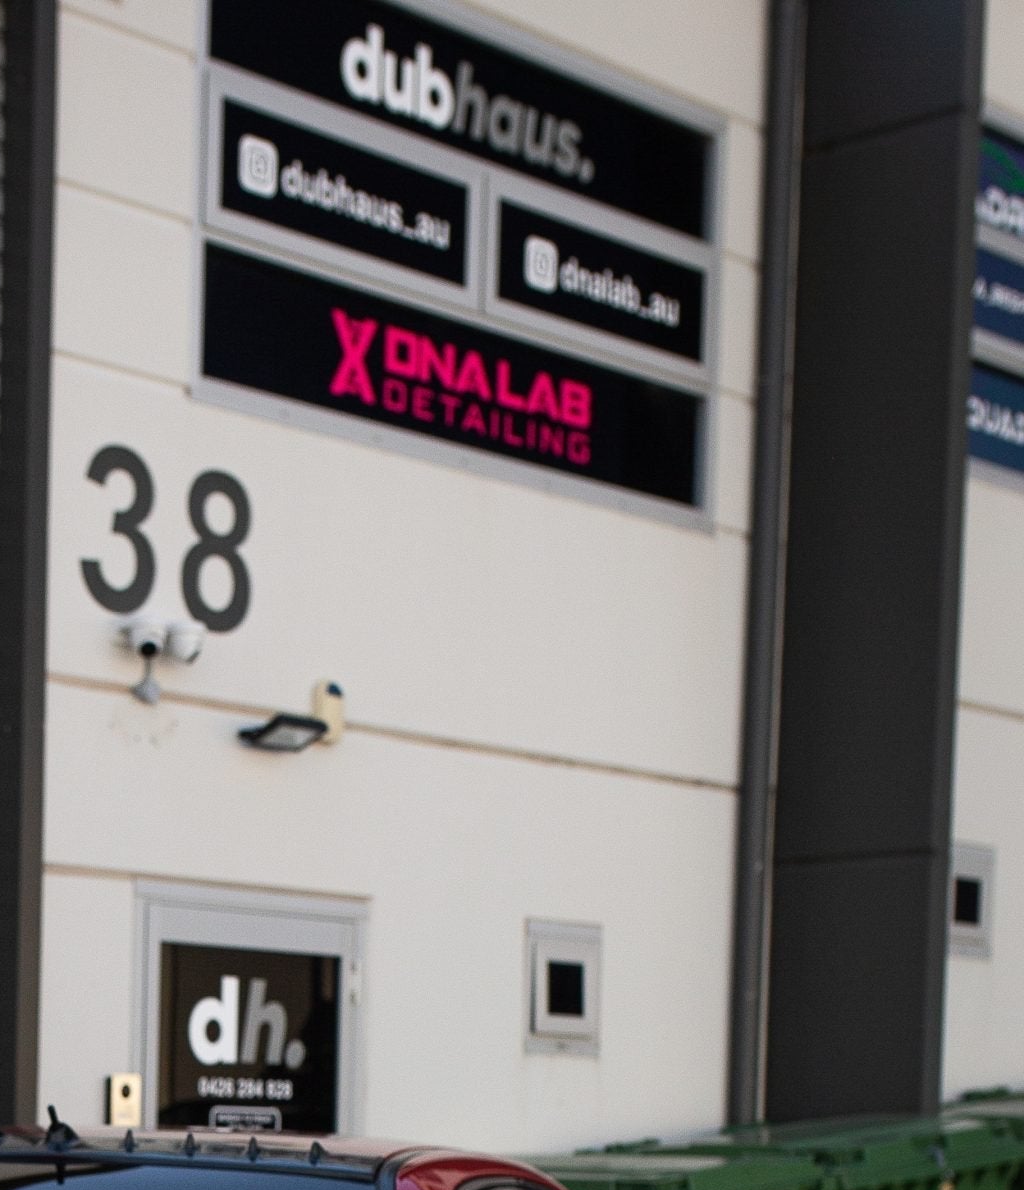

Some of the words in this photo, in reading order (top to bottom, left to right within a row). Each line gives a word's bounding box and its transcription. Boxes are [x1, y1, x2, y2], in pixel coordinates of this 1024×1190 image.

[340, 23, 594, 183] dubhaus.
[281, 158, 452, 250] dubhaus_au
[559, 256, 680, 327] dnalab_au
[383, 324, 490, 400] DNA
[495, 360, 592, 430] LAB
[383, 380, 592, 466] DETAILING
[80, 442, 251, 634] 38
[188, 975, 306, 1070] dh.
